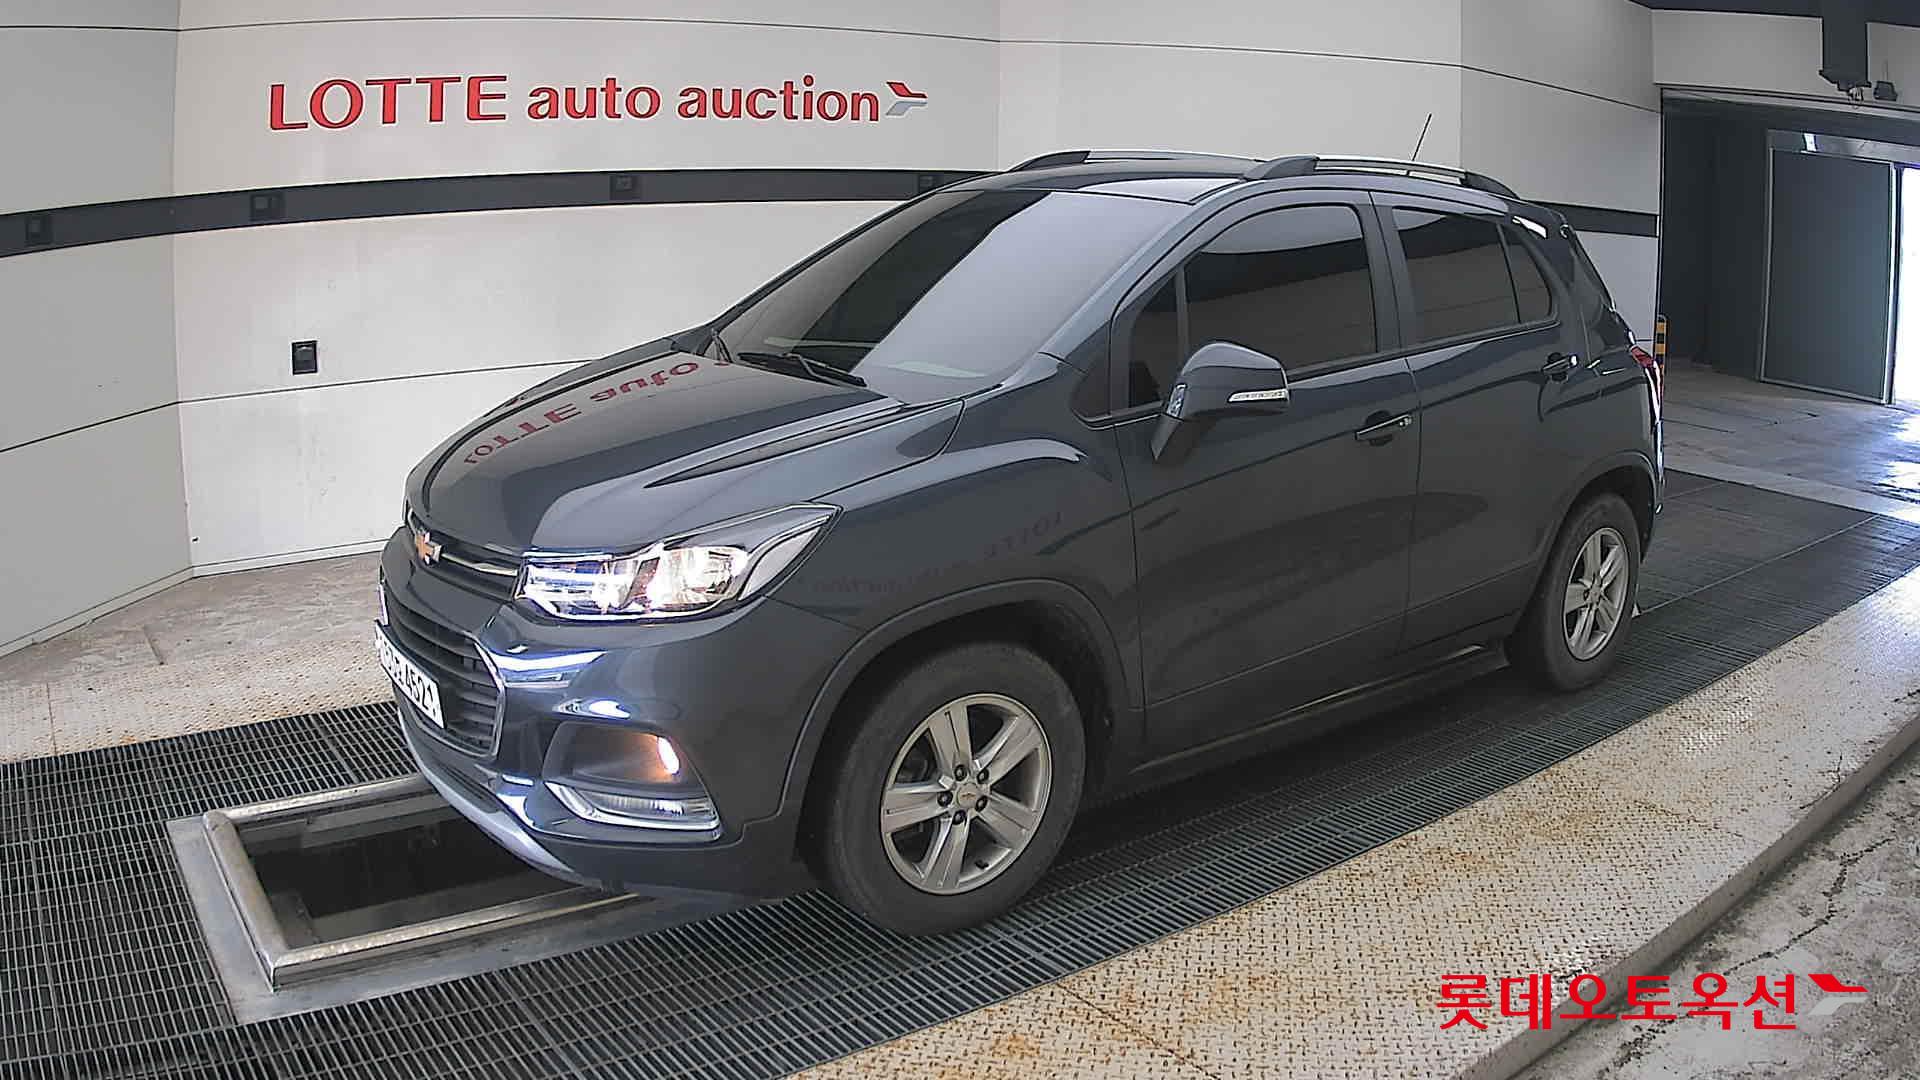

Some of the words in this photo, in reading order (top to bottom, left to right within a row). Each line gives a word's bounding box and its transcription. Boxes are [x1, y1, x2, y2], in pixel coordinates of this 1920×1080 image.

[269, 75, 508, 130] LOTTE
[527, 77, 662, 121] auto
[677, 74, 880, 122] auction
